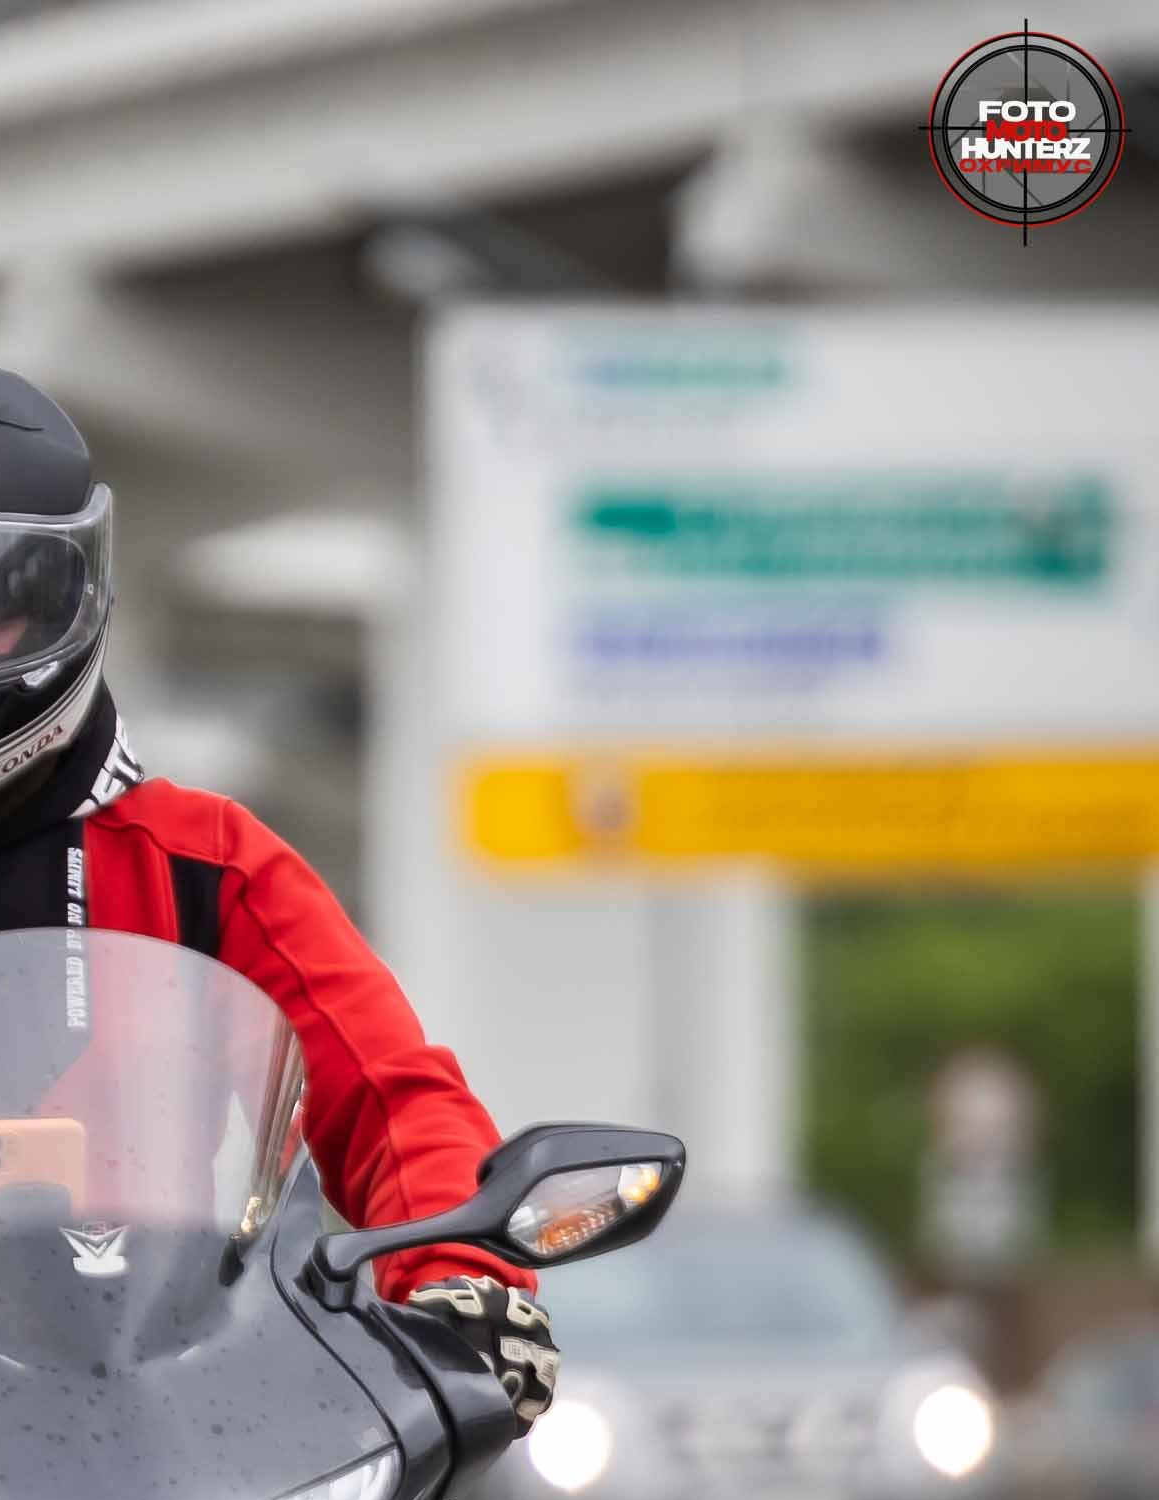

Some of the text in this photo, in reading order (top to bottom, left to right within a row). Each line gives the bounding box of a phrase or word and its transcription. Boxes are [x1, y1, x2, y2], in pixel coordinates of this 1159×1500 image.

[67, 847, 84, 899] LIMITS
[67, 902, 83, 926] NO
[66, 956, 87, 1029] POWERED
